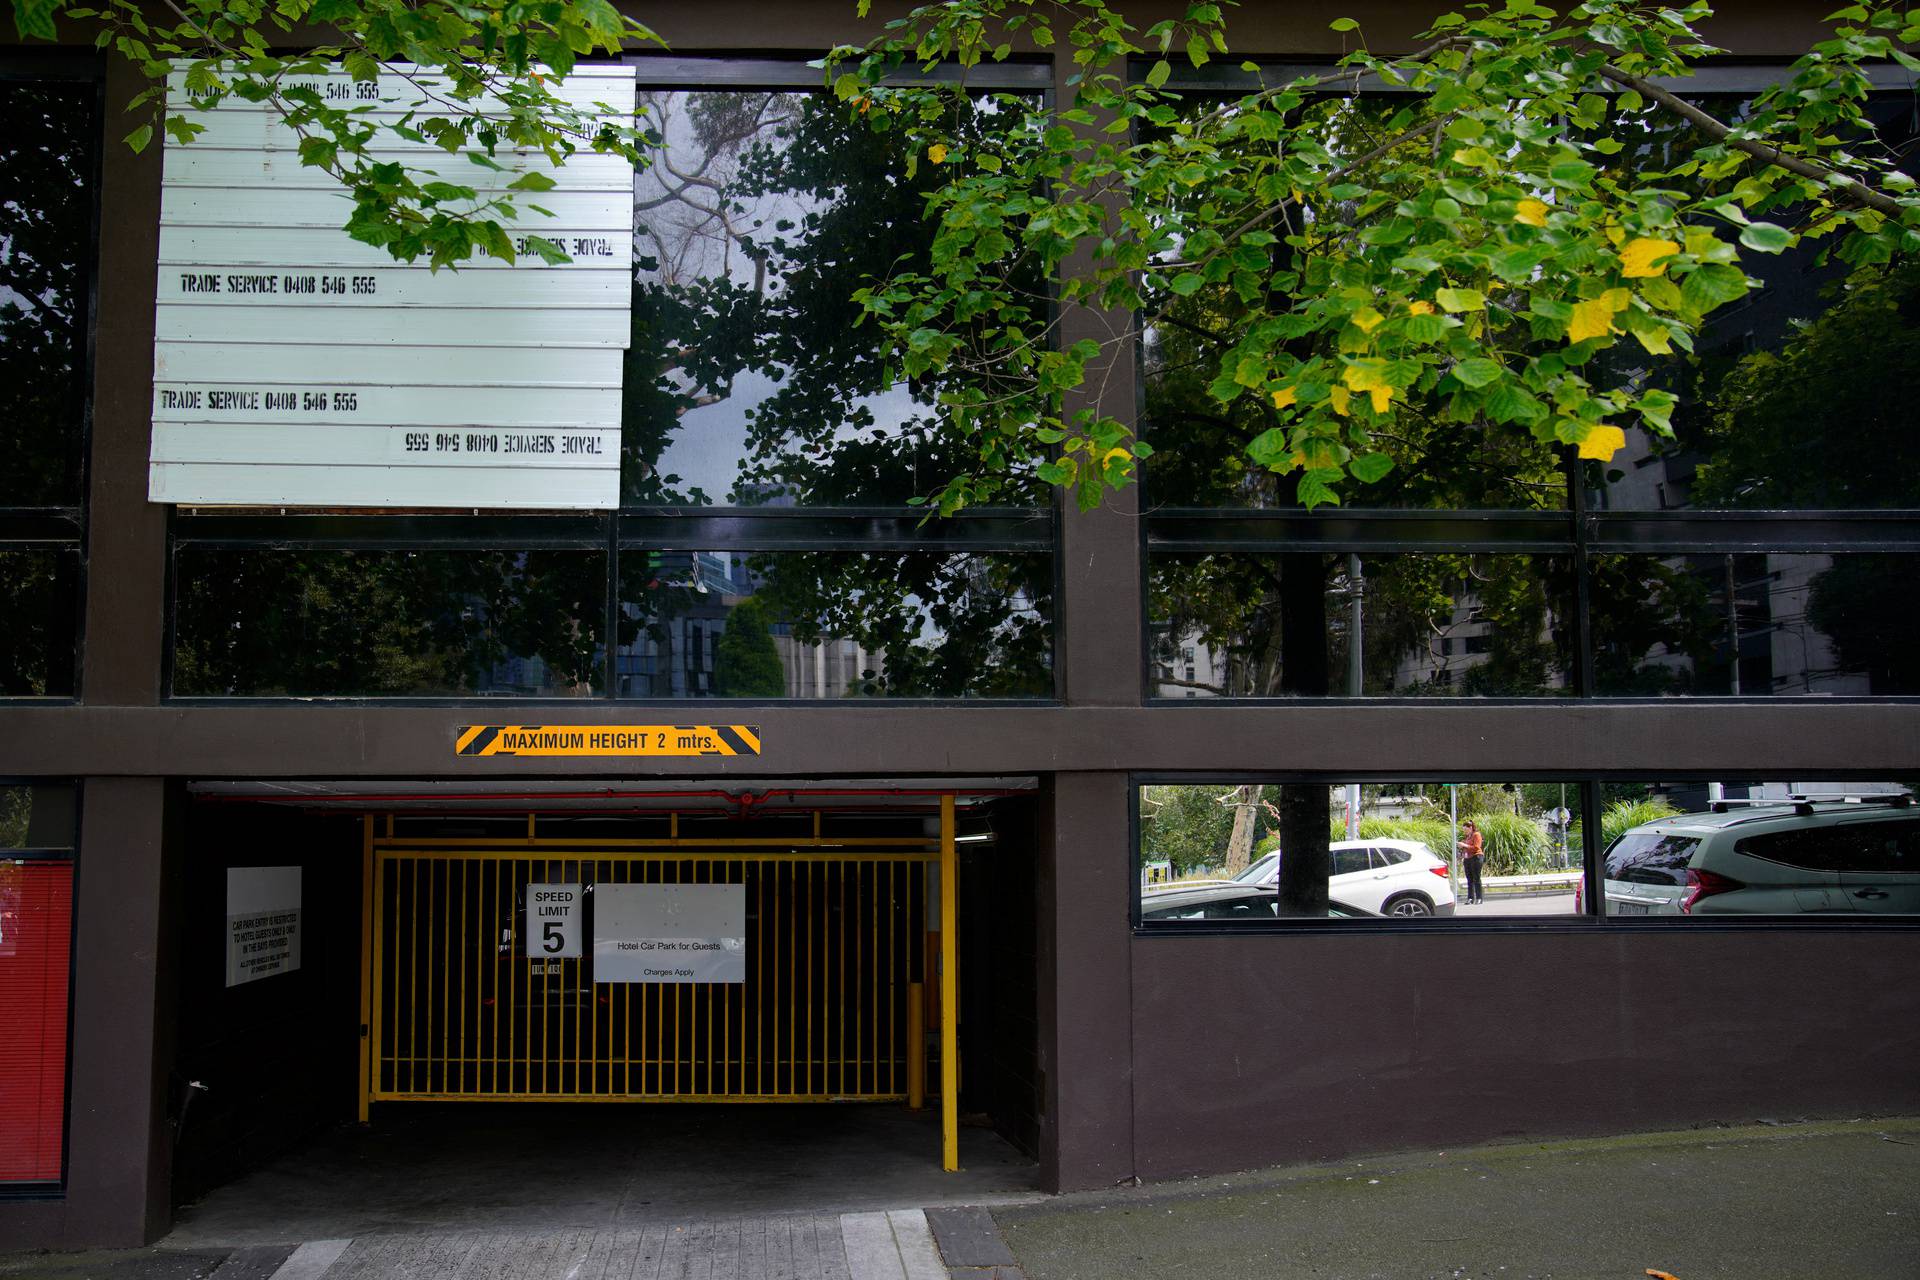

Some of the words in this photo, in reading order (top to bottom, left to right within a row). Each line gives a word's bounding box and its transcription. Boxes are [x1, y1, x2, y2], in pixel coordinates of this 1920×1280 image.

[326, 83, 350, 99] 546
[356, 82, 379, 99] 555
[573, 238, 613, 256] TRADE
[181, 274, 221, 293] TRADE
[227, 275, 278, 294] SERVICE
[284, 275, 316, 294] 0408
[321, 276, 345, 295] 546
[352, 276, 376, 295] 555
[161, 390, 202, 409] TRADE
[208, 391, 259, 410] SERVICE
[265, 392, 297, 411] 0408
[303, 392, 328, 411] 546
[333, 393, 358, 411] 555
[405, 432, 430, 451] 555
[436, 433, 460, 452] 546
[467, 434, 498, 452] 0408
[504, 434, 555, 453] SERVICE
[562, 435, 603, 454] TRADE
[503, 733, 584, 749] MAXIMUM
[590, 733, 649, 749] HEIGHT
[657, 733, 666, 749] 2
[677, 733, 717, 749] mtrs.
[535, 892, 573, 902] SPEED
[538, 906, 571, 916] LIMIT
[232, 920, 242, 931] CAR
[242, 918, 255, 929] PARK
[233, 933, 240, 943] TO
[240, 931, 255, 942] HOTEL
[543, 922, 565, 953] 5
[248, 942, 257, 952] THE
[617, 942, 639, 950] Hotel
[641, 942, 656, 950] Car
[657, 942, 677, 950] Park
[678, 942, 690, 950] for
[692, 942, 721, 951] Guests
[643, 968, 673, 977] Charges
[674, 968, 695, 977] Apply
